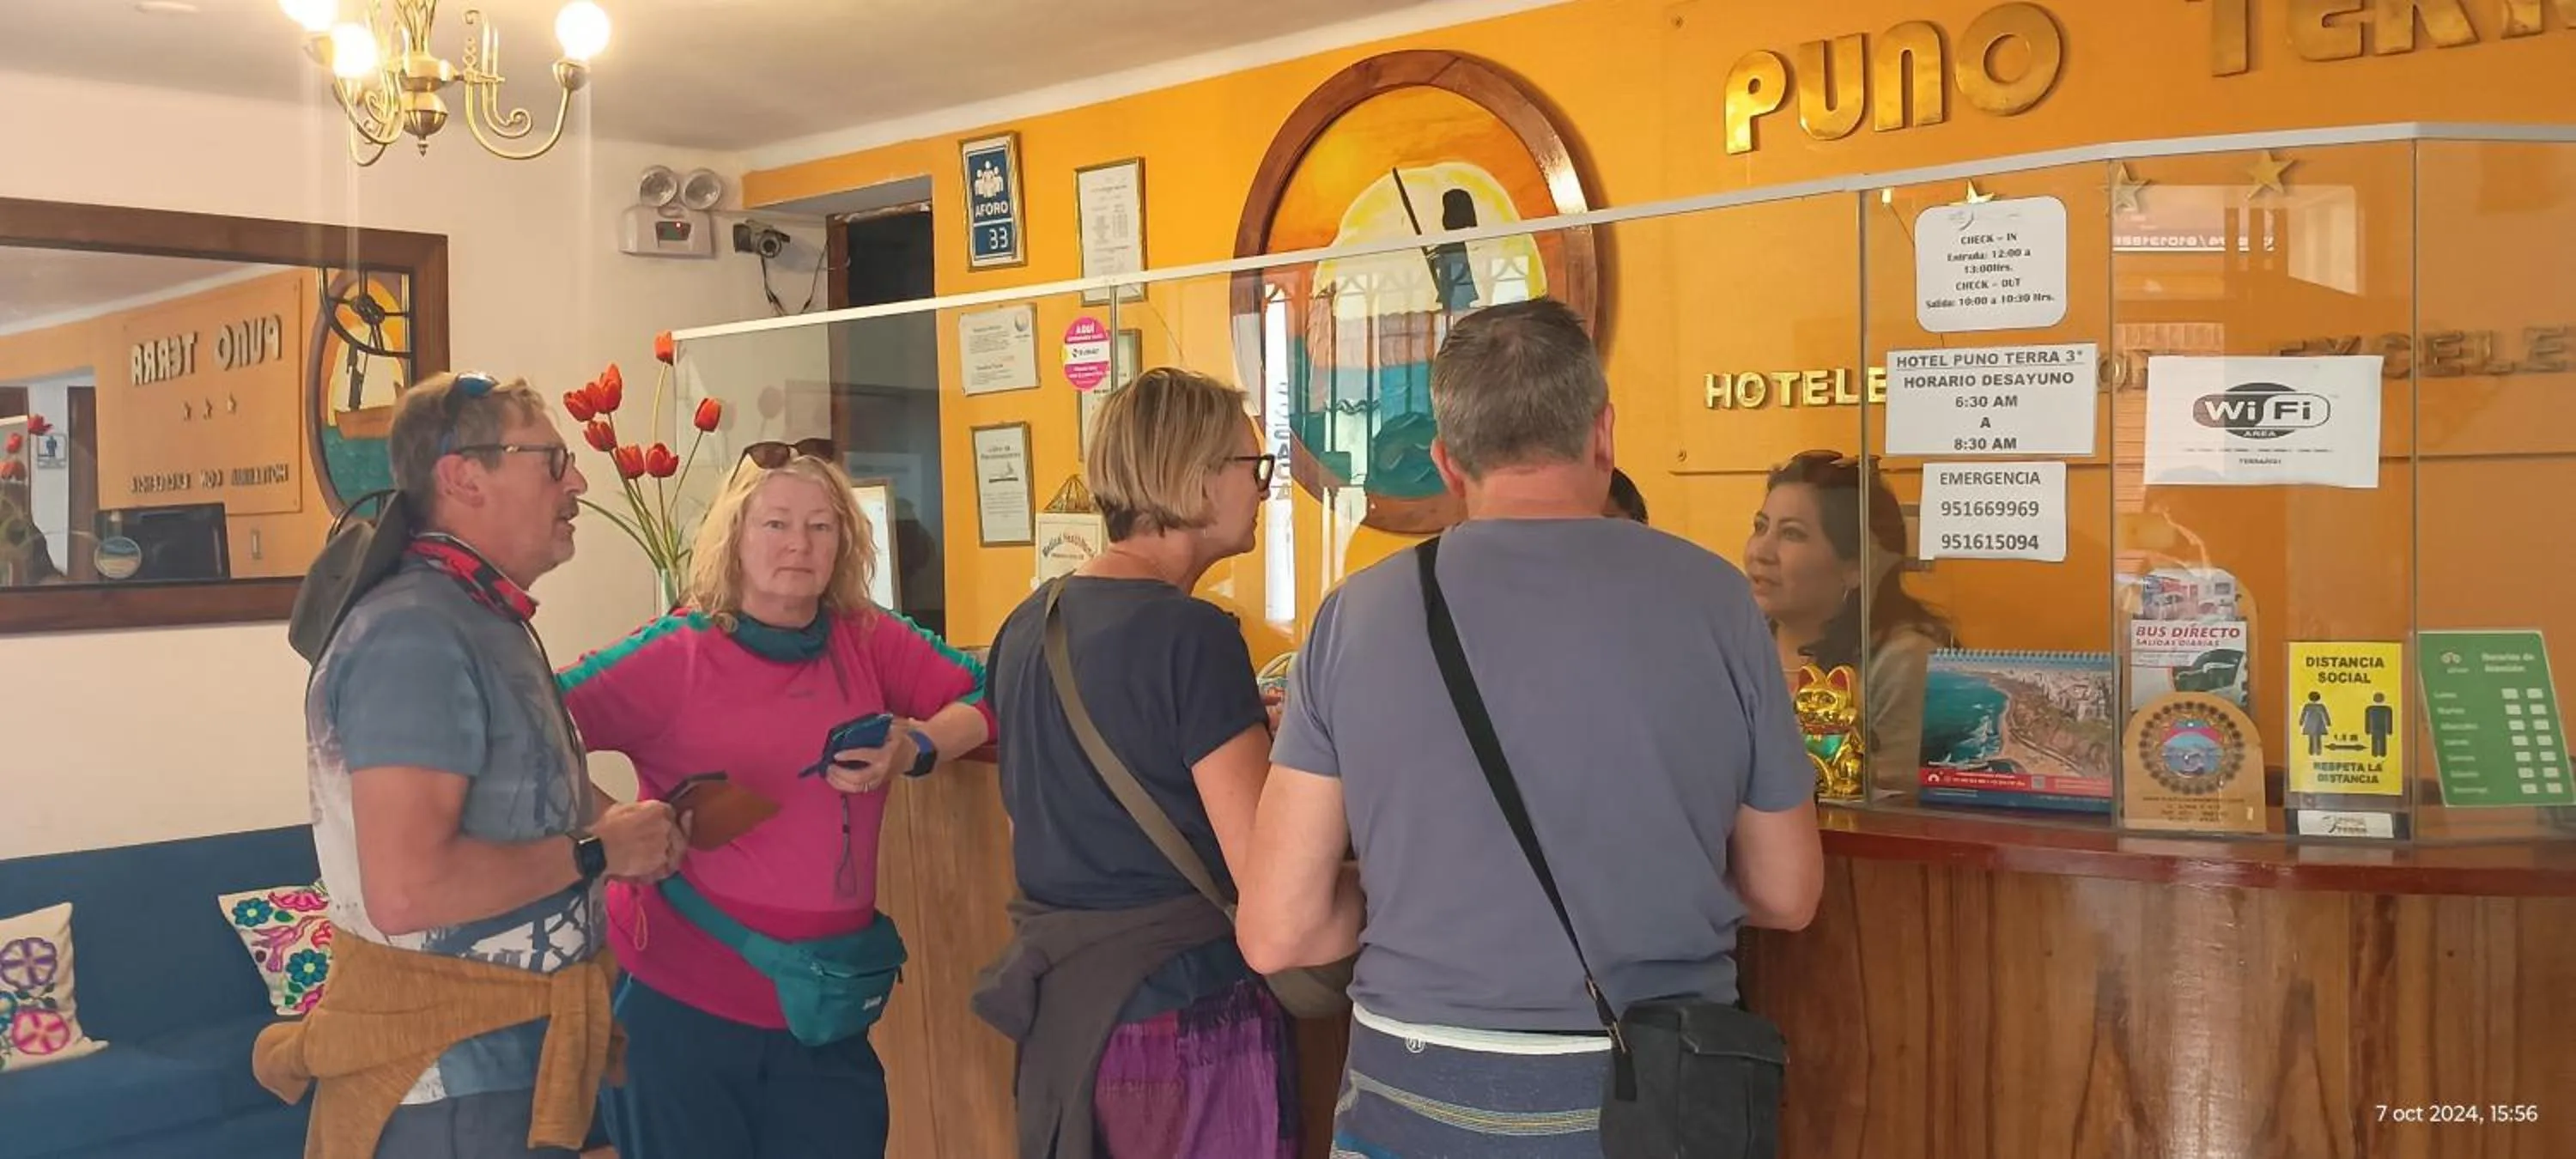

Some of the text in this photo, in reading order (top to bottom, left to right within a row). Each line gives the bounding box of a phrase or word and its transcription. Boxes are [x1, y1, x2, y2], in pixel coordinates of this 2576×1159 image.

[1724, 2, 2063, 155] PUNO
[975, 201, 1009, 217] AFORO
[988, 227, 1009, 250] 33
[1960, 234, 1994, 245] CHECK
[2007, 233, 2017, 241] IN
[1947, 252, 1988, 262] Entrada:
[1992, 248, 2021, 258] 12:00
[1955, 280, 1989, 291] CHECK
[2002, 278, 2020, 288] OUT
[1959, 296, 1988, 306] 10:00
[2001, 294, 2031, 304] 10:30
[1896, 355, 1948, 369] HOTEL
[1953, 353, 1999, 367] PUNO
[2005, 351, 2060, 364] TERRA
[1904, 373, 2075, 388] HORARIO DESAYUNO
[1704, 367, 1886, 409] HOTELE
[1955, 395, 2018, 408] 6:30 AM
[1979, 416, 1991, 428] A
[1953, 438, 2018, 451] 8:30 AM
[1940, 471, 2041, 485] EMERGENCIA
[1941, 501, 2040, 517] 951669969
[1941, 534, 2039, 550] 951615094
[2136, 626, 2240, 639] BUS DIRECTO
[2306, 656, 2385, 668] DISTANCIA
[2318, 671, 2372, 683] SOCIAL
[2313, 762, 2383, 773] RESPETA LA
[2318, 774, 2379, 784] DISTANCIA
